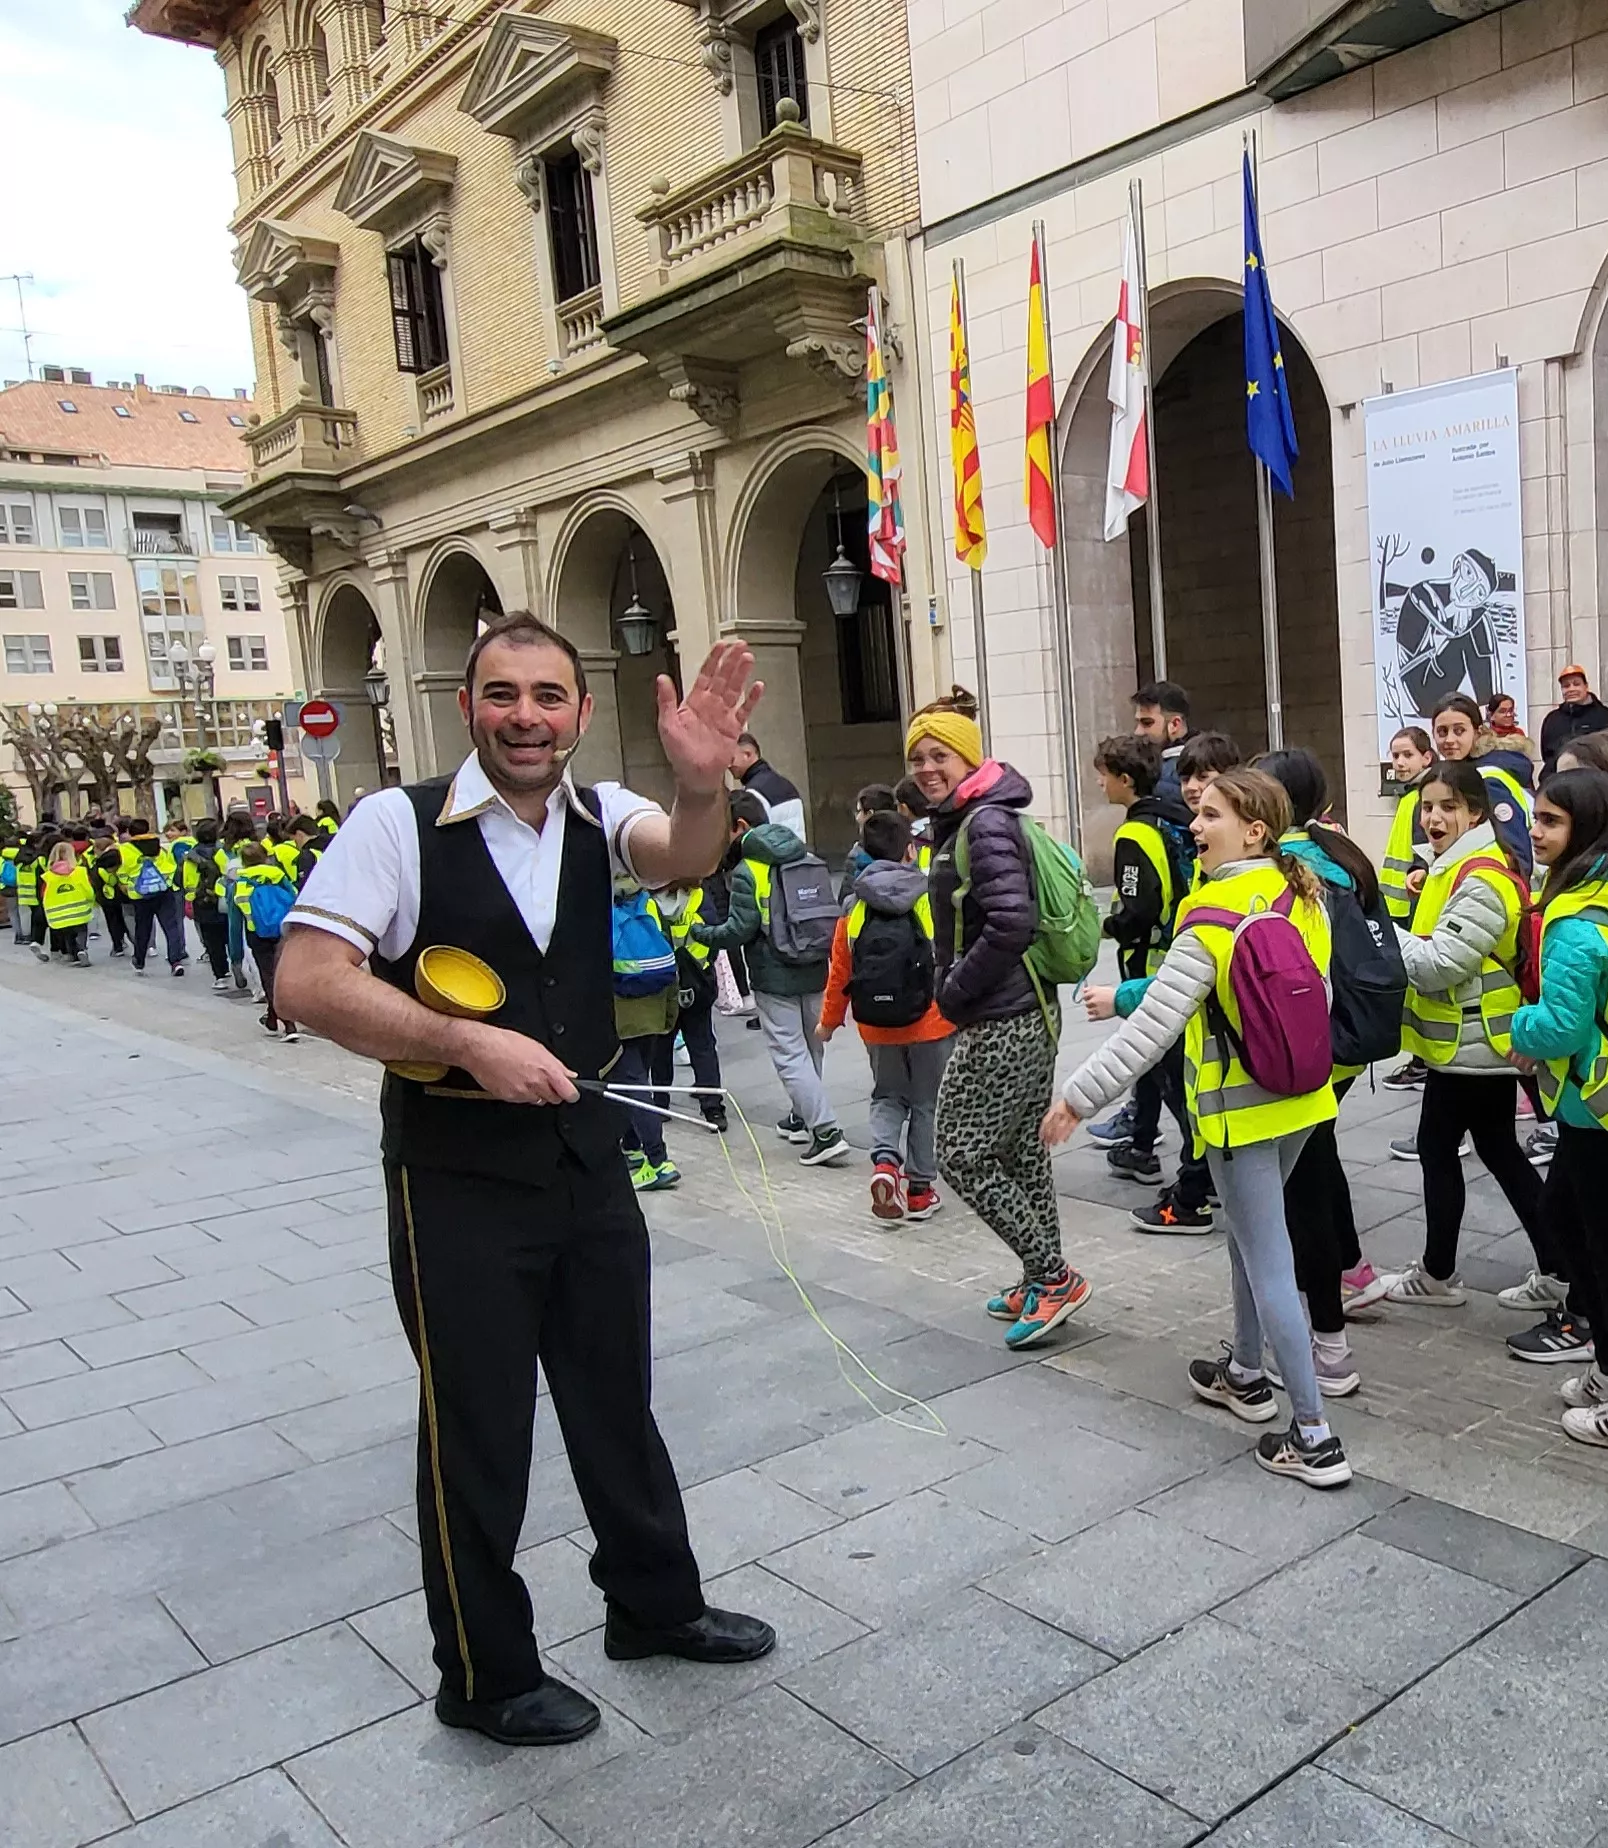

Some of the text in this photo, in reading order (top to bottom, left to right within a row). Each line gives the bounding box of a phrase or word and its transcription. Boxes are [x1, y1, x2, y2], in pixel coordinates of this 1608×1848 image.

[1374, 415, 1510, 452] LA LLUVIA AMARILLA
